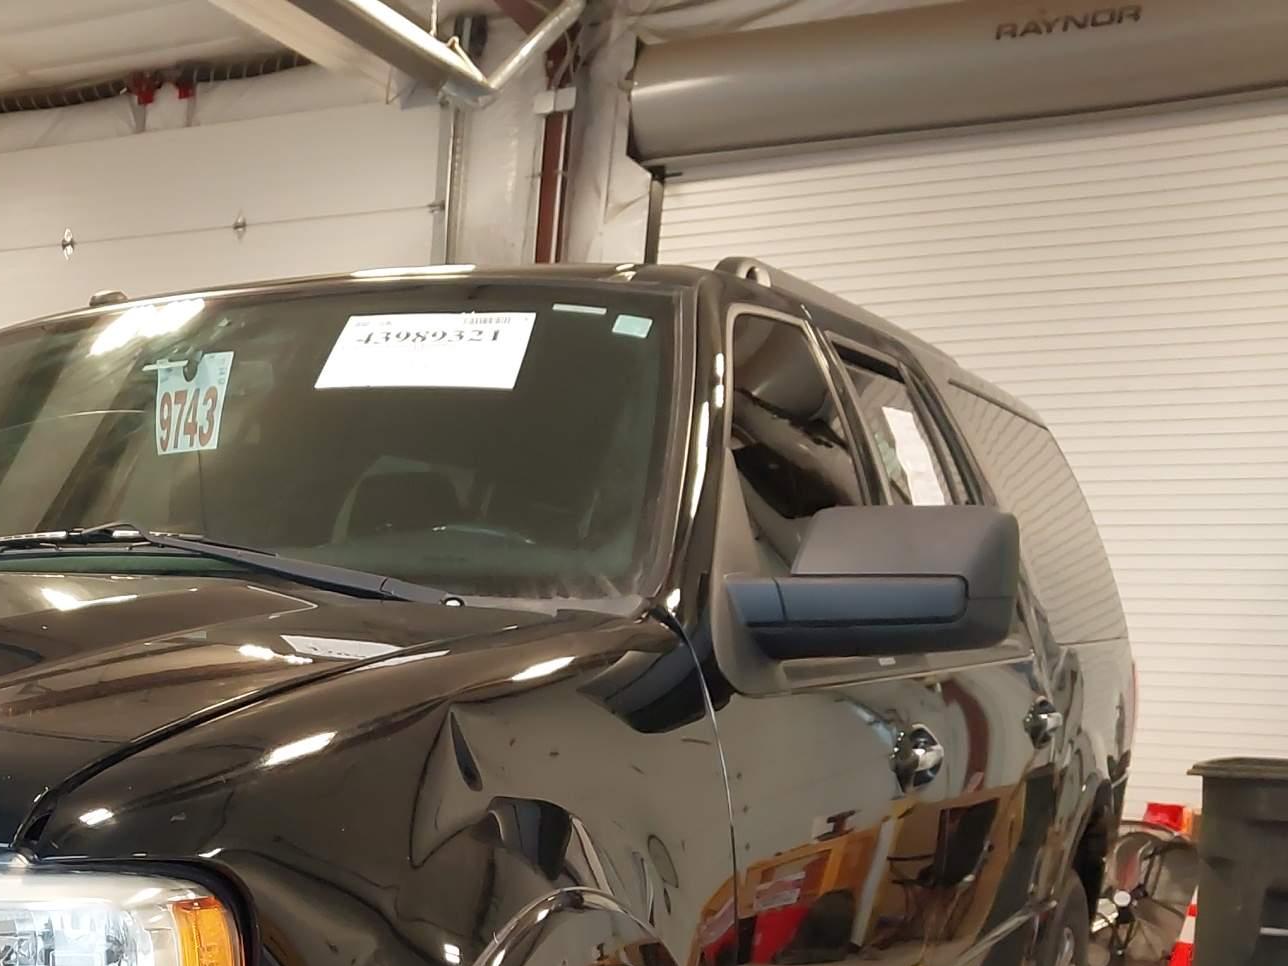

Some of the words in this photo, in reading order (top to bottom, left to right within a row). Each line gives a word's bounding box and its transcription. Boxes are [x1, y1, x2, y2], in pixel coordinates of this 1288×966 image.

[995, 5, 1142, 40] RAYNOR
[355, 328, 501, 344] 43989321
[159, 386, 218, 452] 9743
